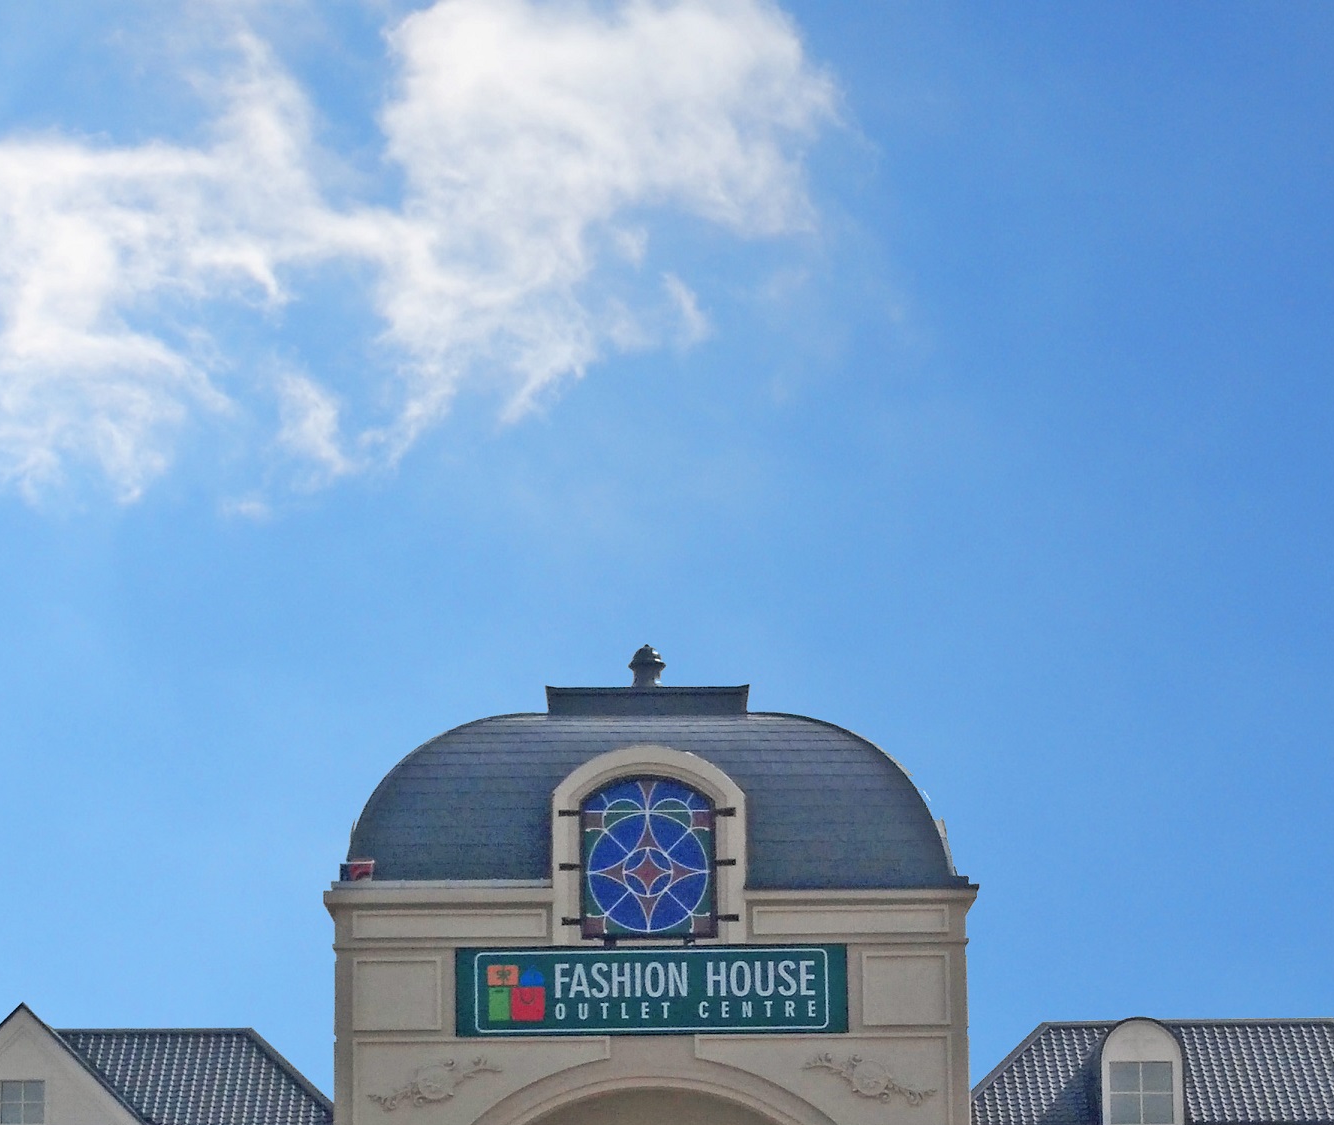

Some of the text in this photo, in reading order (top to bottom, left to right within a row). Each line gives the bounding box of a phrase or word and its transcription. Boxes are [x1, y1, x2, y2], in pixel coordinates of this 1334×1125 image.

[554, 960, 816, 998] FASHION HOUSE
[555, 1000, 816, 1020] OUTLET CENTRE
